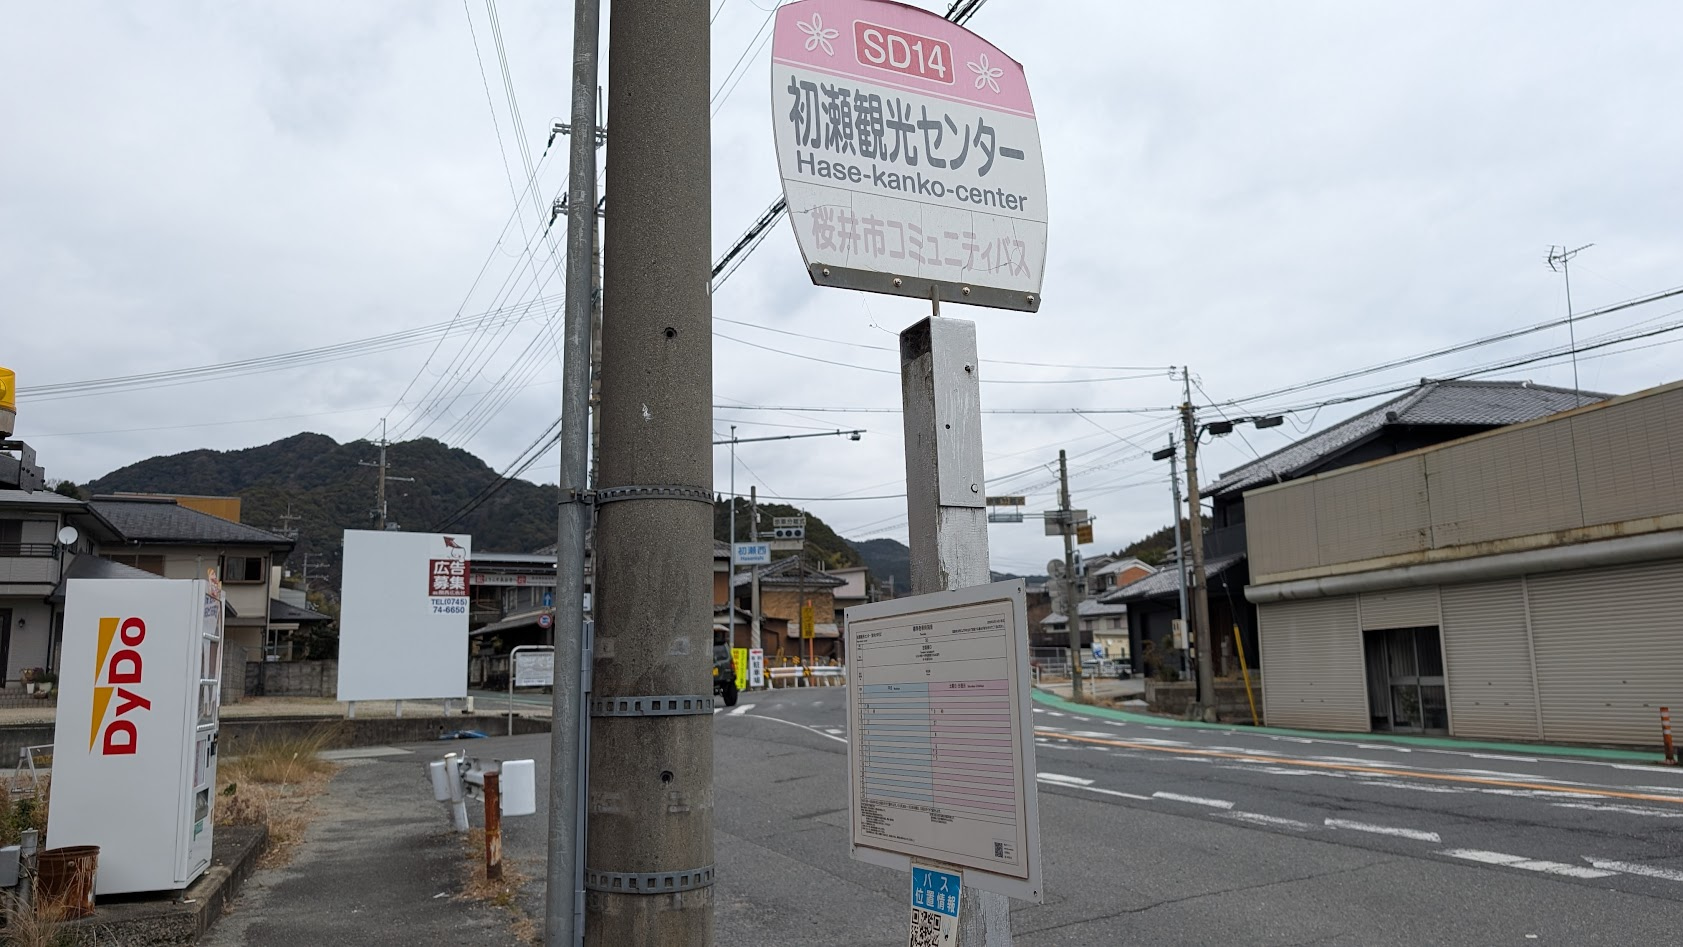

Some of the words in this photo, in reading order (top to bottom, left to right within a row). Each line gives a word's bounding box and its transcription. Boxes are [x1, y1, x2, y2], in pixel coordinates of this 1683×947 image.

[862, 28, 947, 78] SD14
[787, 74, 1025, 178] 初瀬観光センター
[796, 150, 1028, 212] Hase-kanko-center
[811, 205, 1032, 279] 桜井市コミュニティバス
[433, 560, 466, 575] 広告
[738, 545, 767, 555] 初瀬西
[433, 575, 466, 590] 募集
[102, 617, 151, 756] DyDo
[915, 887, 956, 913] 位置情報
[923, 872, 949, 893] バス
